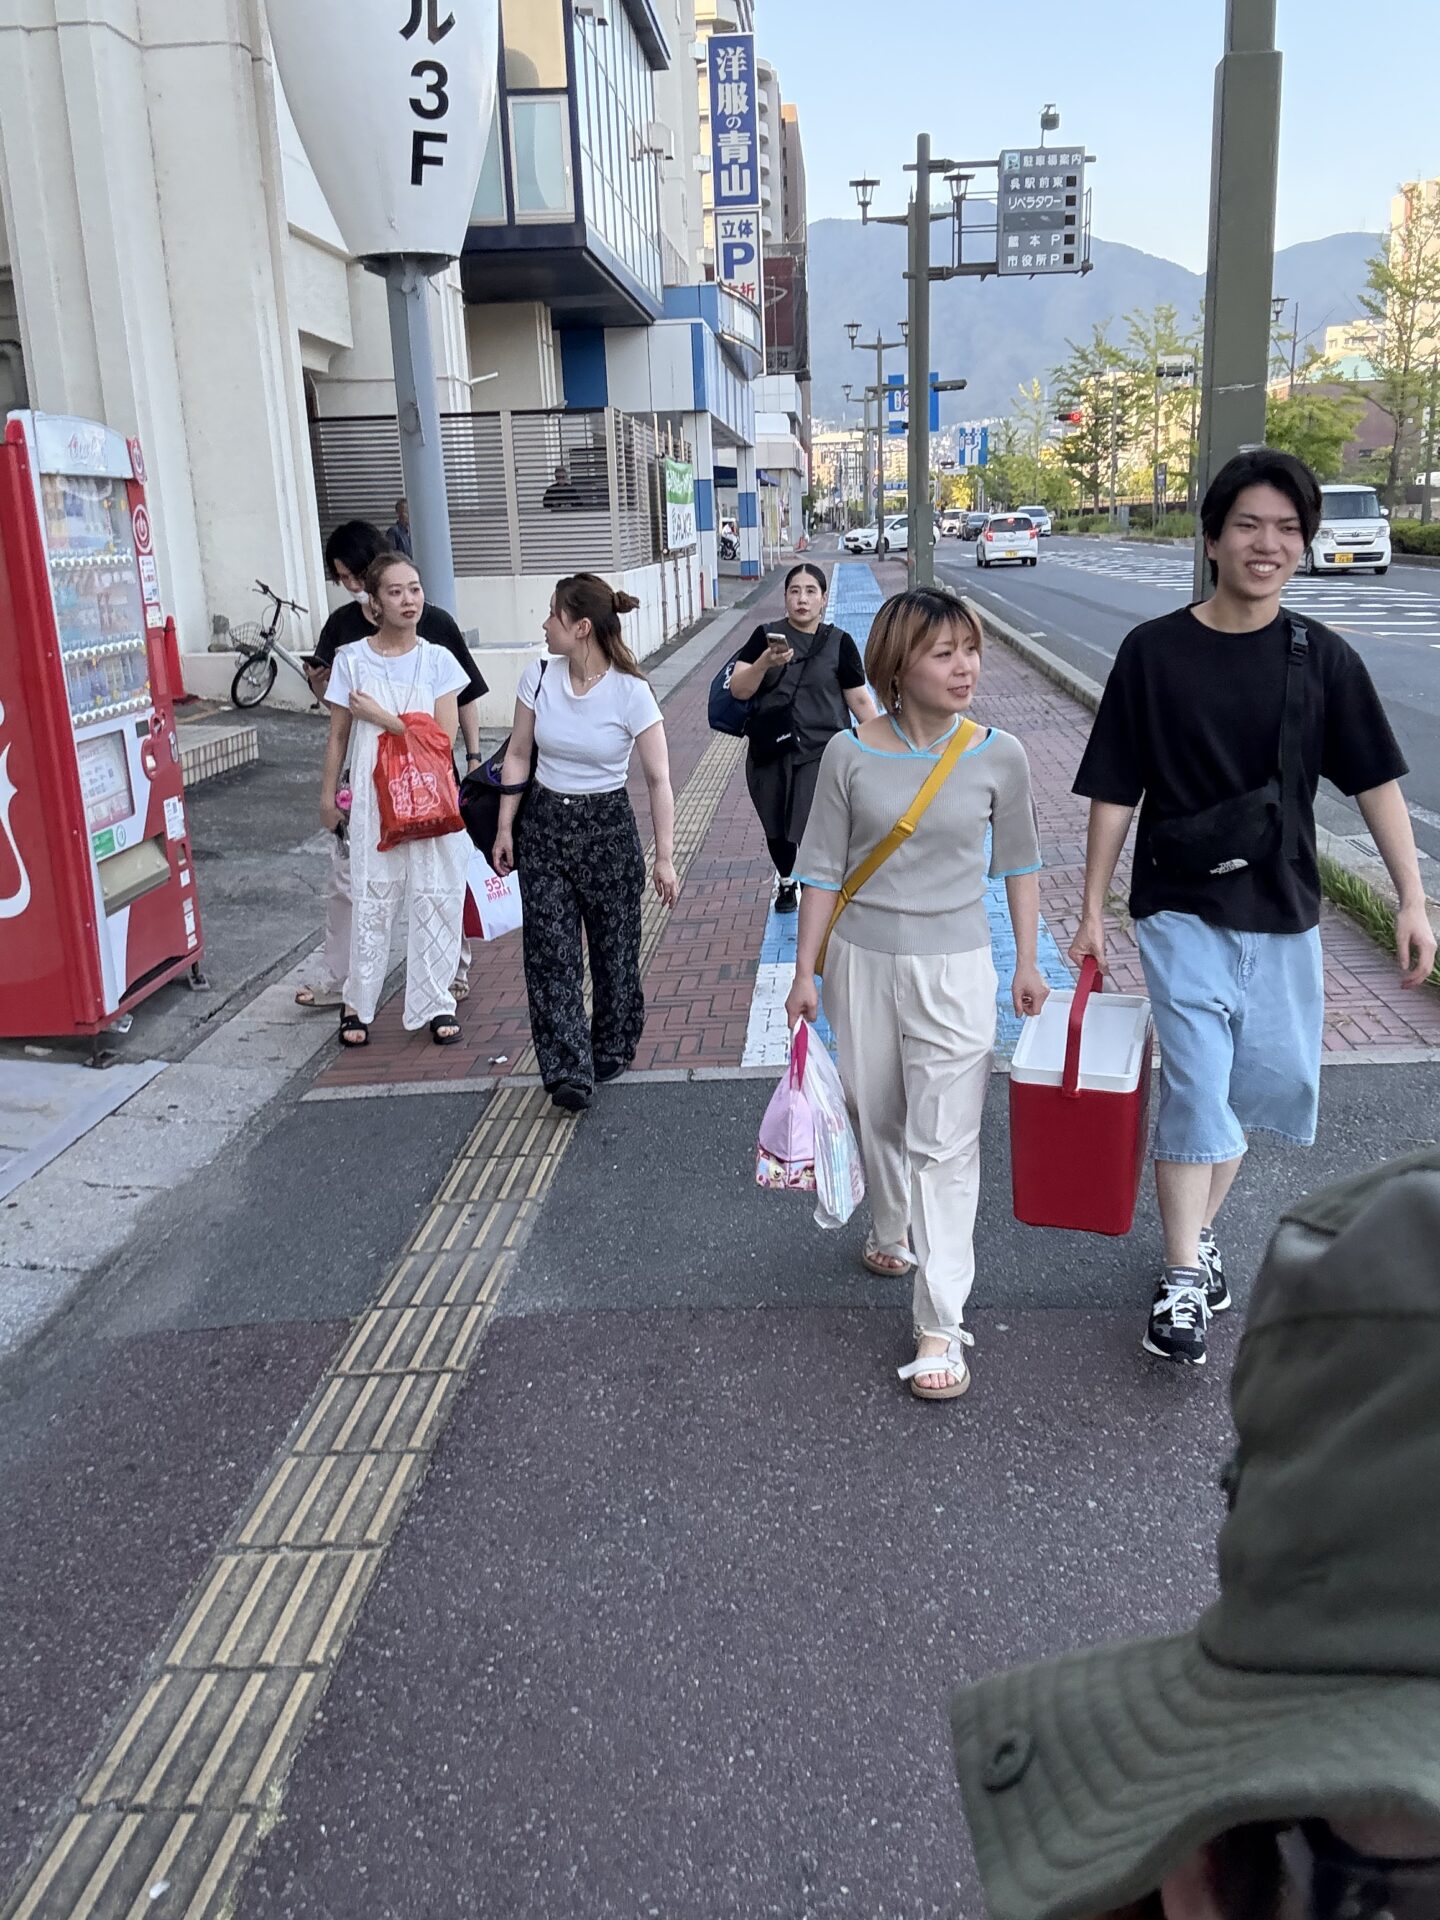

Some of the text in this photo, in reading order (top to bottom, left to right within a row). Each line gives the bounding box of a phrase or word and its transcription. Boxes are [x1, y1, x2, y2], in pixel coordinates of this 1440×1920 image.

[715, 46, 752, 198] 洋服の青山
[1023, 153, 1082, 167] 駐車場案内
[1010, 176, 1064, 190] 呉駅前東
[721, 219, 754, 239] 立体
[722, 242, 755, 280] P
